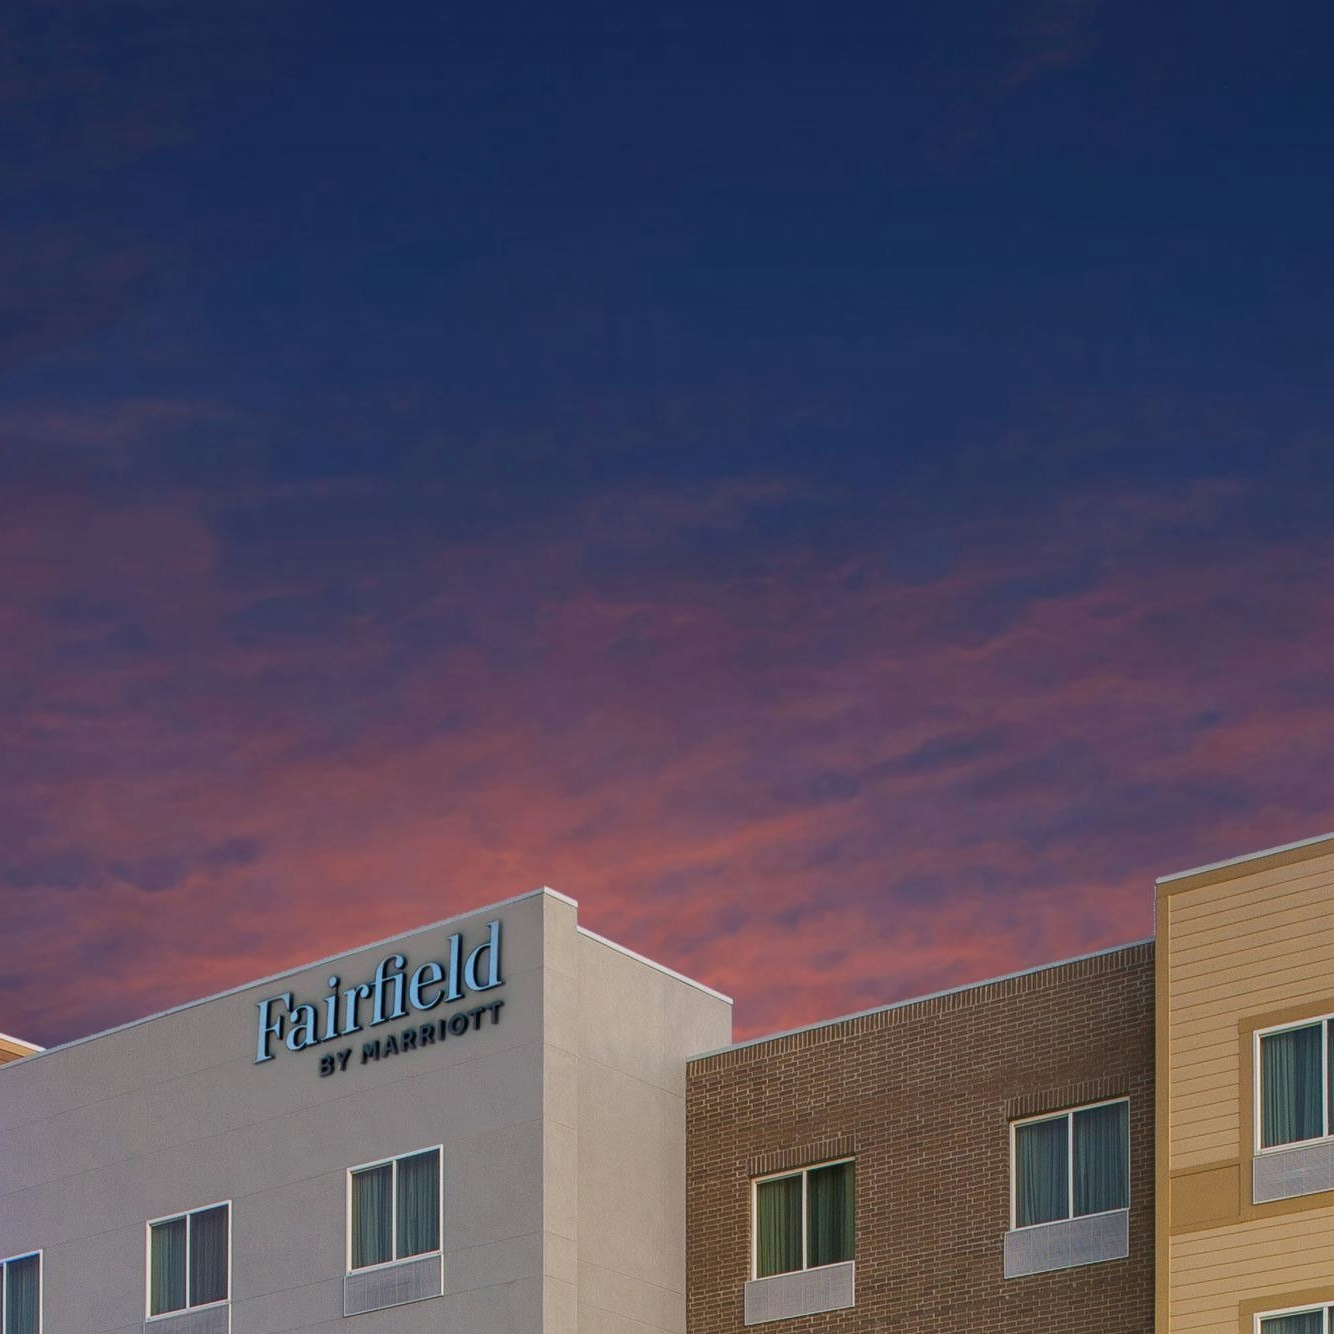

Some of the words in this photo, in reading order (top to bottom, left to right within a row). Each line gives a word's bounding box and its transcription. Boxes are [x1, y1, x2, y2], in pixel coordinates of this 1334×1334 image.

[253, 919, 505, 1065] Fairfield
[319, 1048, 352, 1078] BY
[360, 1000, 505, 1065] MARRIOTT
